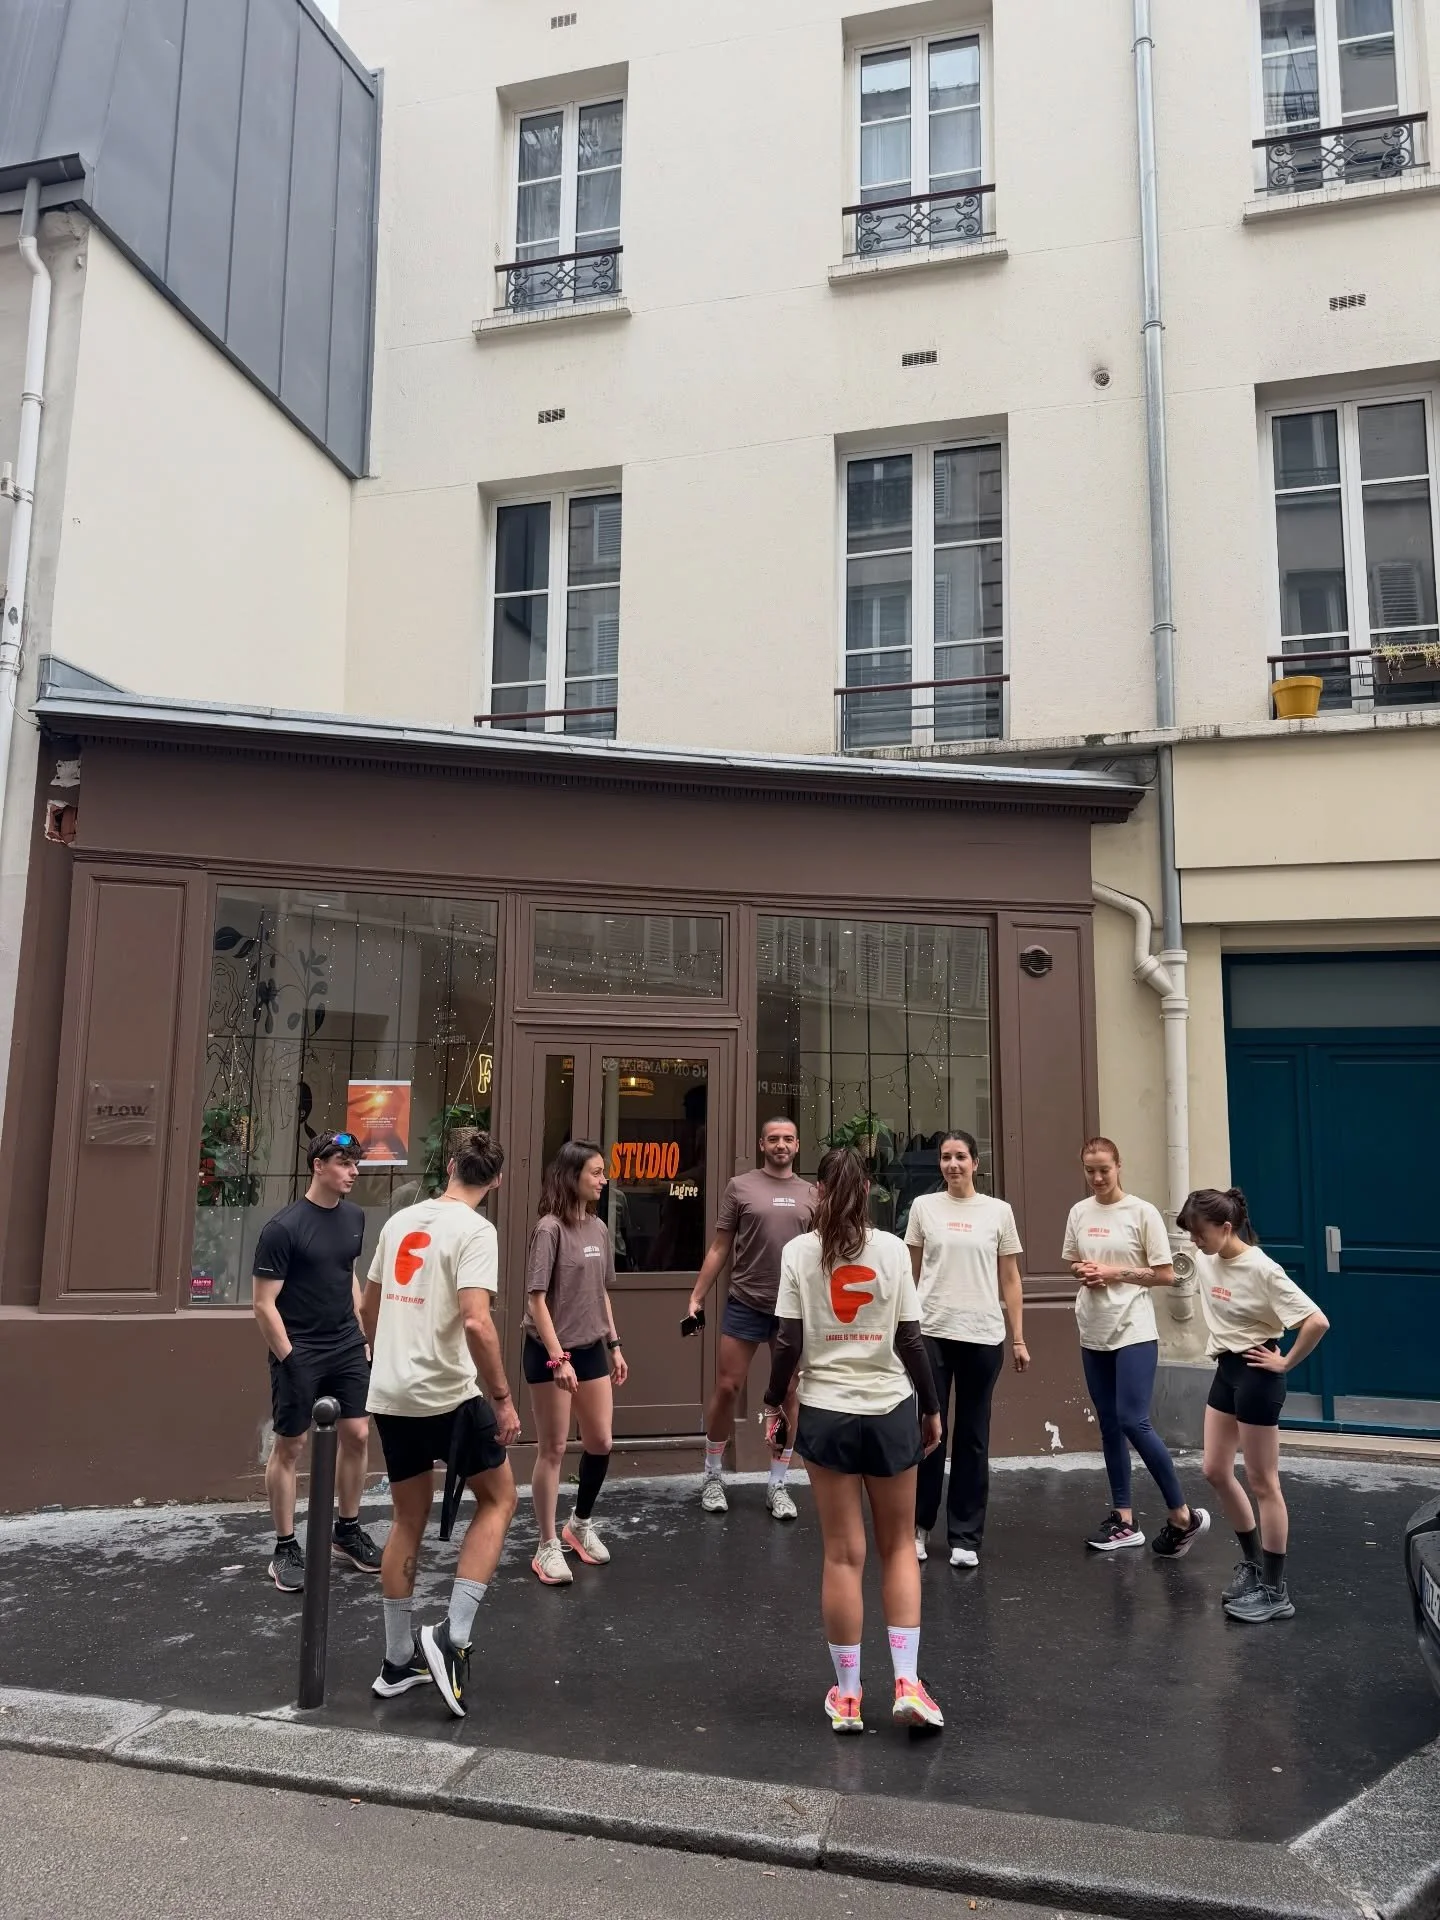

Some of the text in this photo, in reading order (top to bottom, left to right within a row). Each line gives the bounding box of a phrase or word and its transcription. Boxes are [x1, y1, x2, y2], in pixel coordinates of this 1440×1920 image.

[97, 1105, 149, 1117] FLOW
[609, 1142, 680, 1179] STUDIO
[669, 1183, 698, 1200] Lagree
